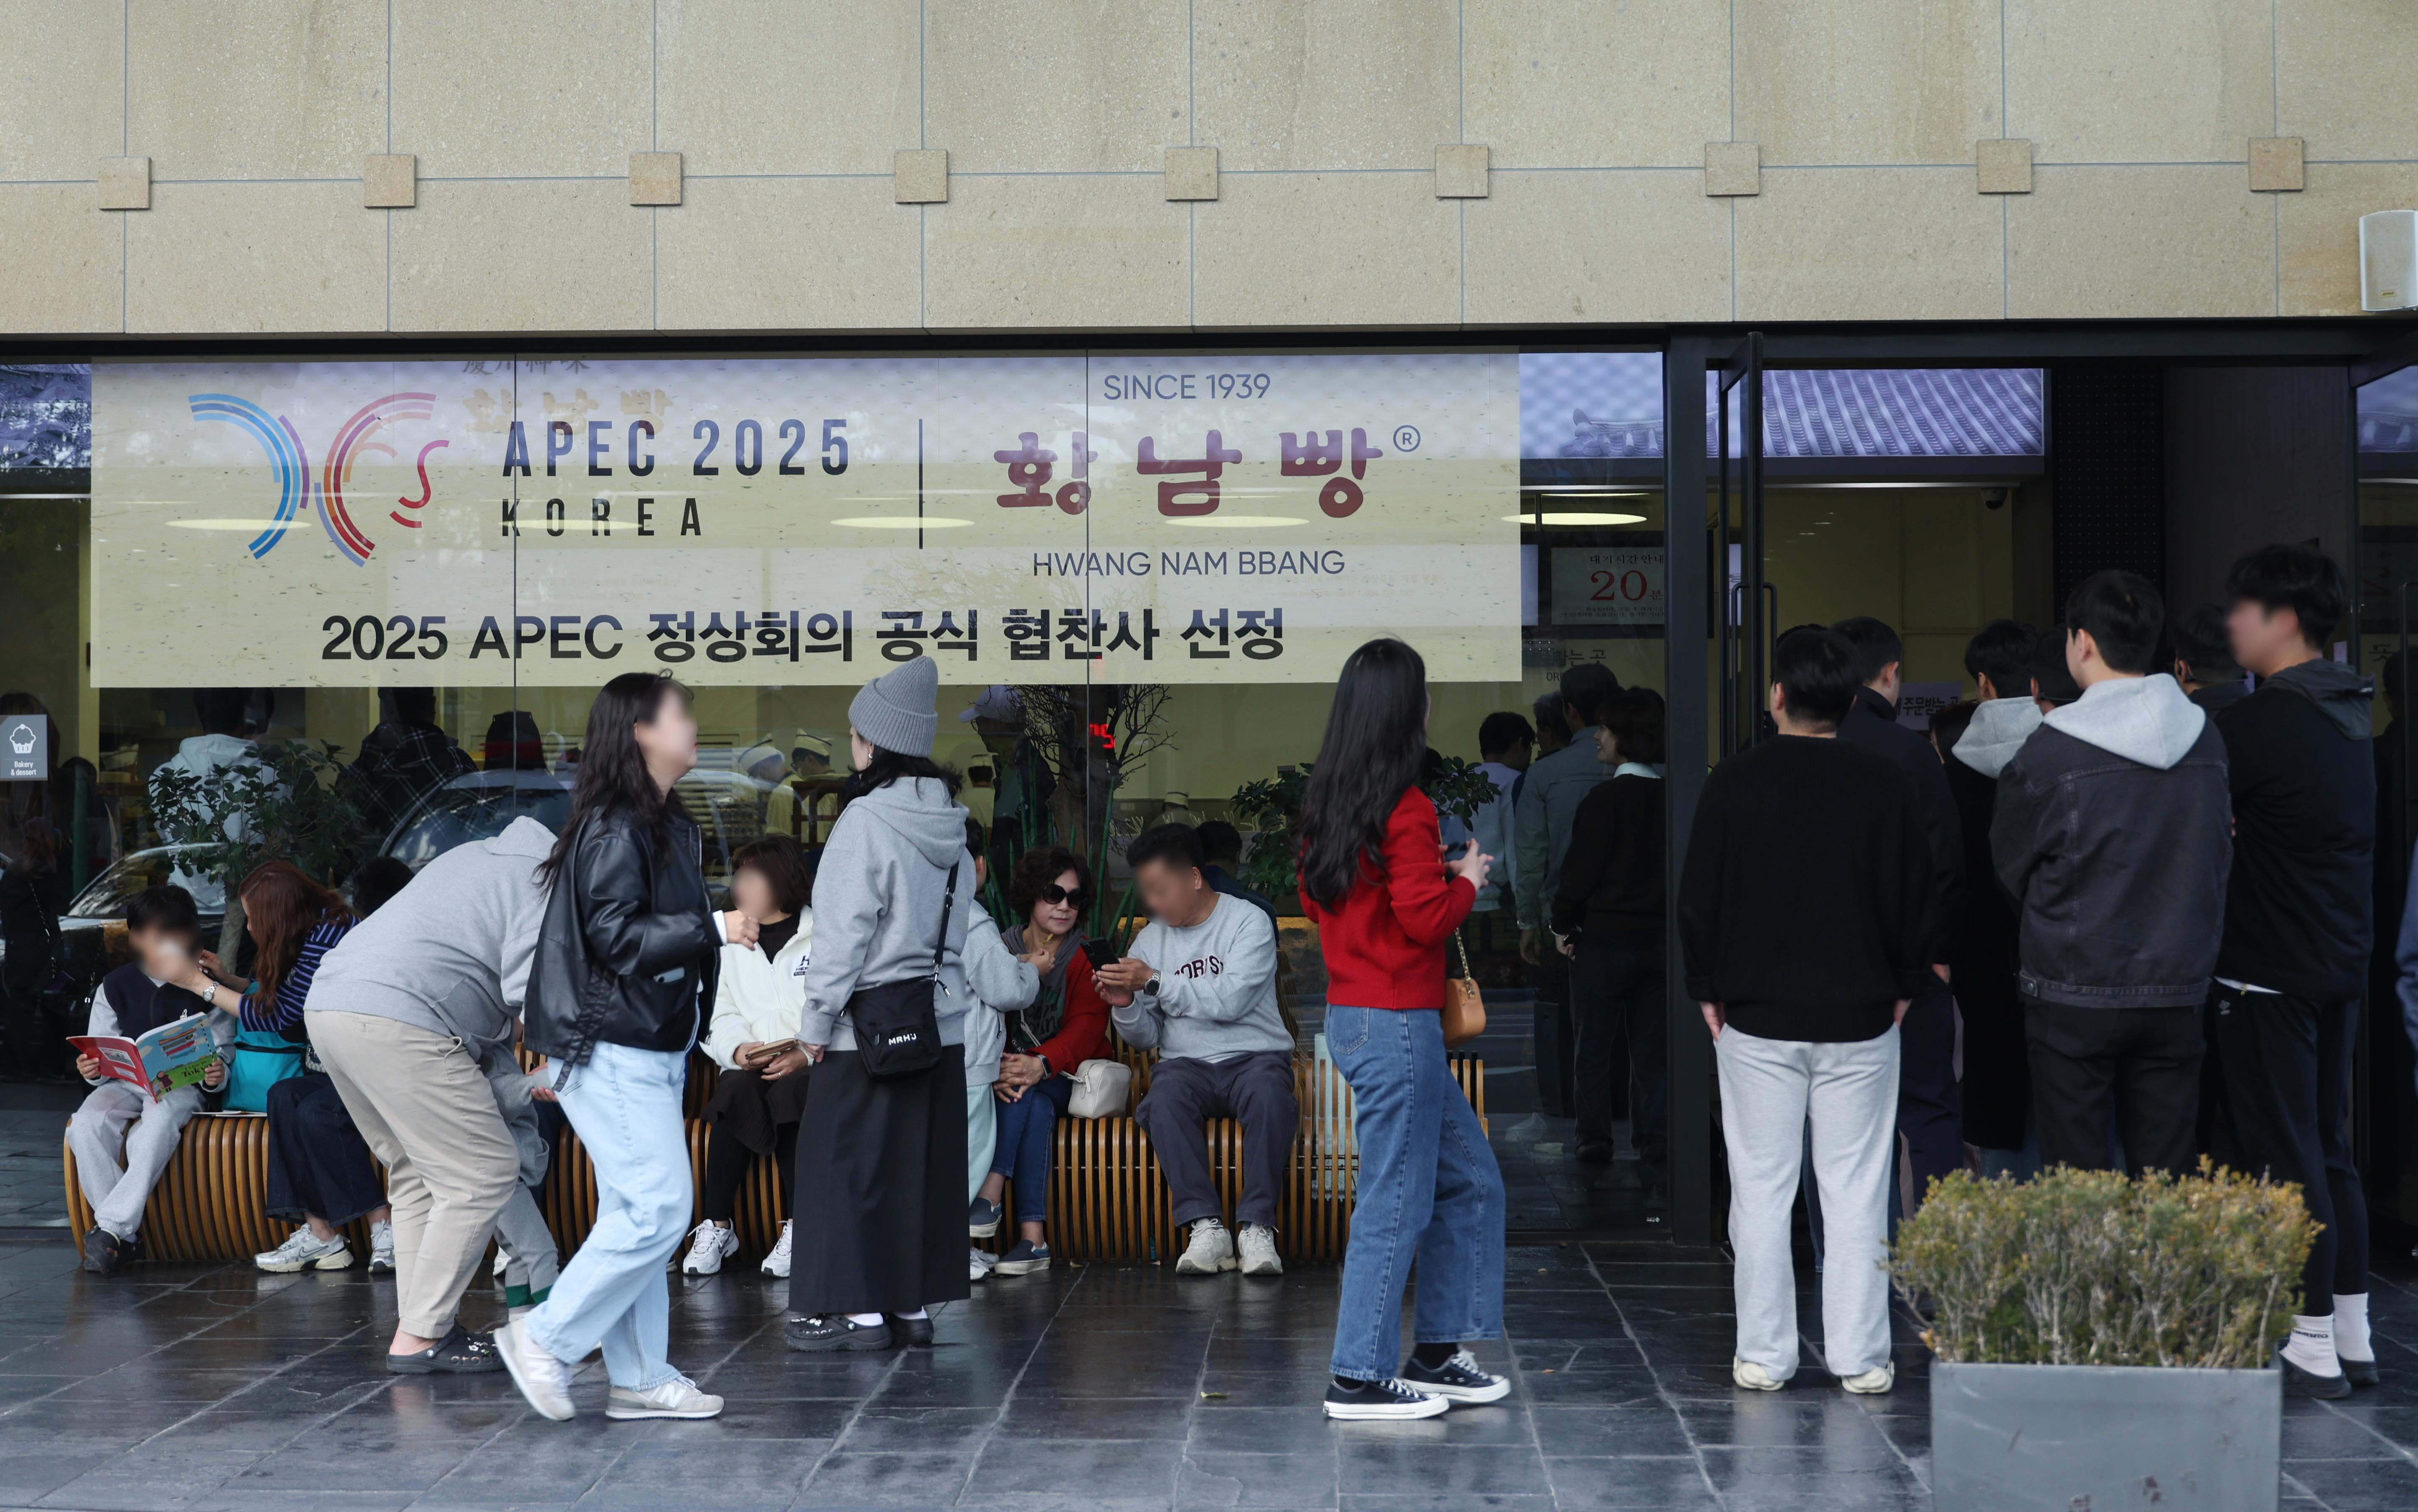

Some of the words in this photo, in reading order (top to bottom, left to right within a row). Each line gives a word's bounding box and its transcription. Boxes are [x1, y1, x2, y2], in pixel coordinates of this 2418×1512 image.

[1104, 374, 1196, 400] SINCE
[1206, 373, 1271, 400] 1939
[502, 419, 655, 477] APEC
[693, 418, 849, 477] 2025
[502, 498, 702, 537] KOREA
[1033, 551, 1151, 577] HWANG
[1161, 551, 1228, 576] NAM
[1239, 550, 1346, 575] BBANG
[1590, 570, 1648, 601] 20
[322, 615, 448, 660] 2025
[469, 614, 623, 660] APEC
[647, 610, 853, 663] 정상회의
[876, 609, 978, 661] 공식
[1003, 608, 1160, 661] 협찬사
[1180, 608, 1284, 660] 선정
